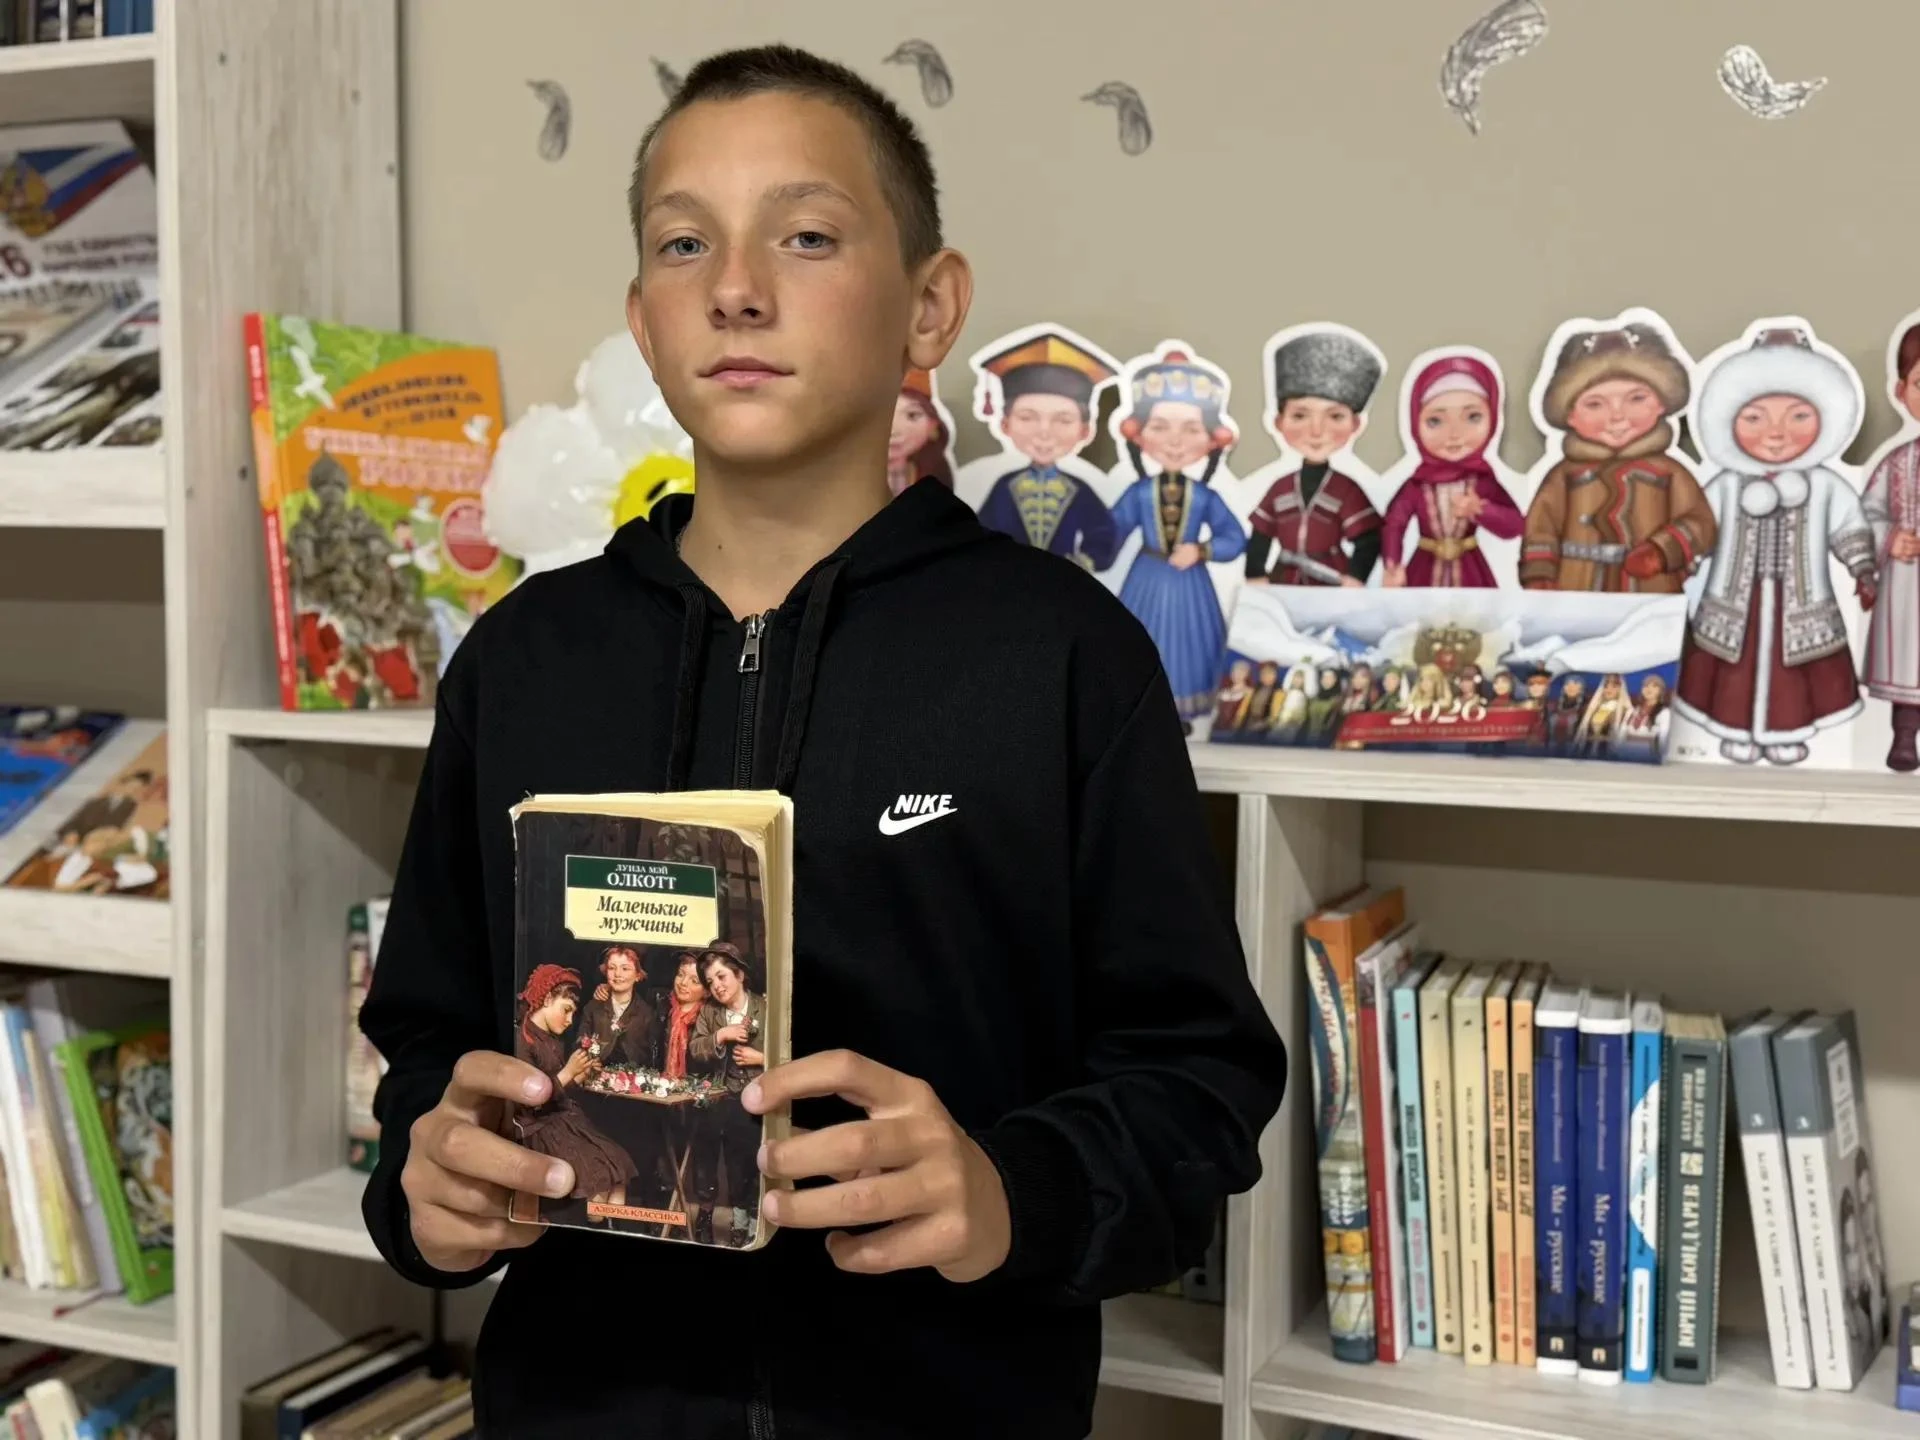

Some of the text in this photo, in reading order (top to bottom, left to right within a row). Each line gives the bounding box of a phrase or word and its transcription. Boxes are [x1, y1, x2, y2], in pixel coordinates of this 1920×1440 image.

[893, 794, 953, 814] NIKE
[607, 872, 677, 889] ОЛКОТТ
[615, 863, 668, 875] ЛУИЗА МЭЙ
[596, 895, 688, 917] Маленькие
[599, 917, 684, 935] мужчины
[1551, 1184, 1568, 1214] Мы
[1594, 1193, 1611, 1223] Мы
[1546, 1229, 1563, 1294] русские
[1589, 1239, 1606, 1304] русские
[1676, 1184, 1701, 1348] ЮРИЙ БОНДАРЕВ
